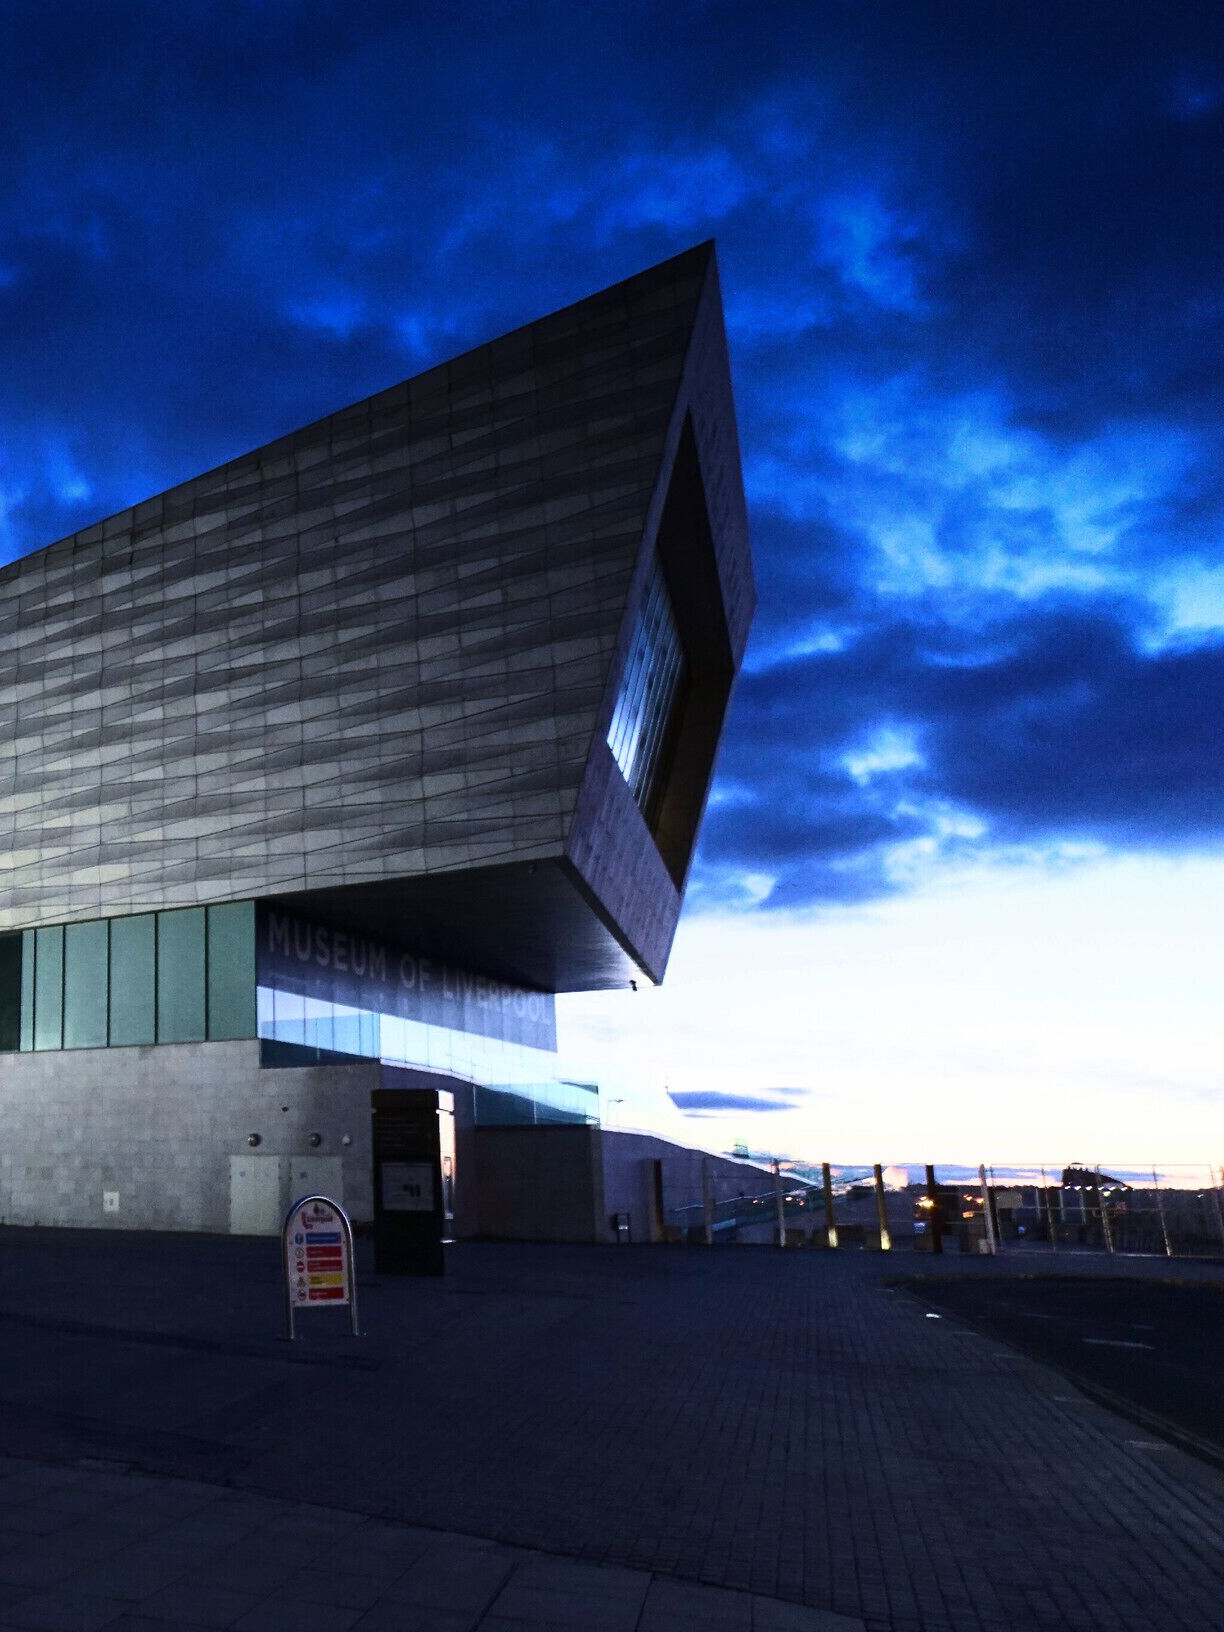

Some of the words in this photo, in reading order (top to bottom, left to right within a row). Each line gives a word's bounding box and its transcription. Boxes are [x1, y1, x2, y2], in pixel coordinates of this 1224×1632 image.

[268, 912, 387, 982] MUSEUM
[400, 953, 432, 992] OF
[443, 964, 552, 1026] LIVERPOOL
